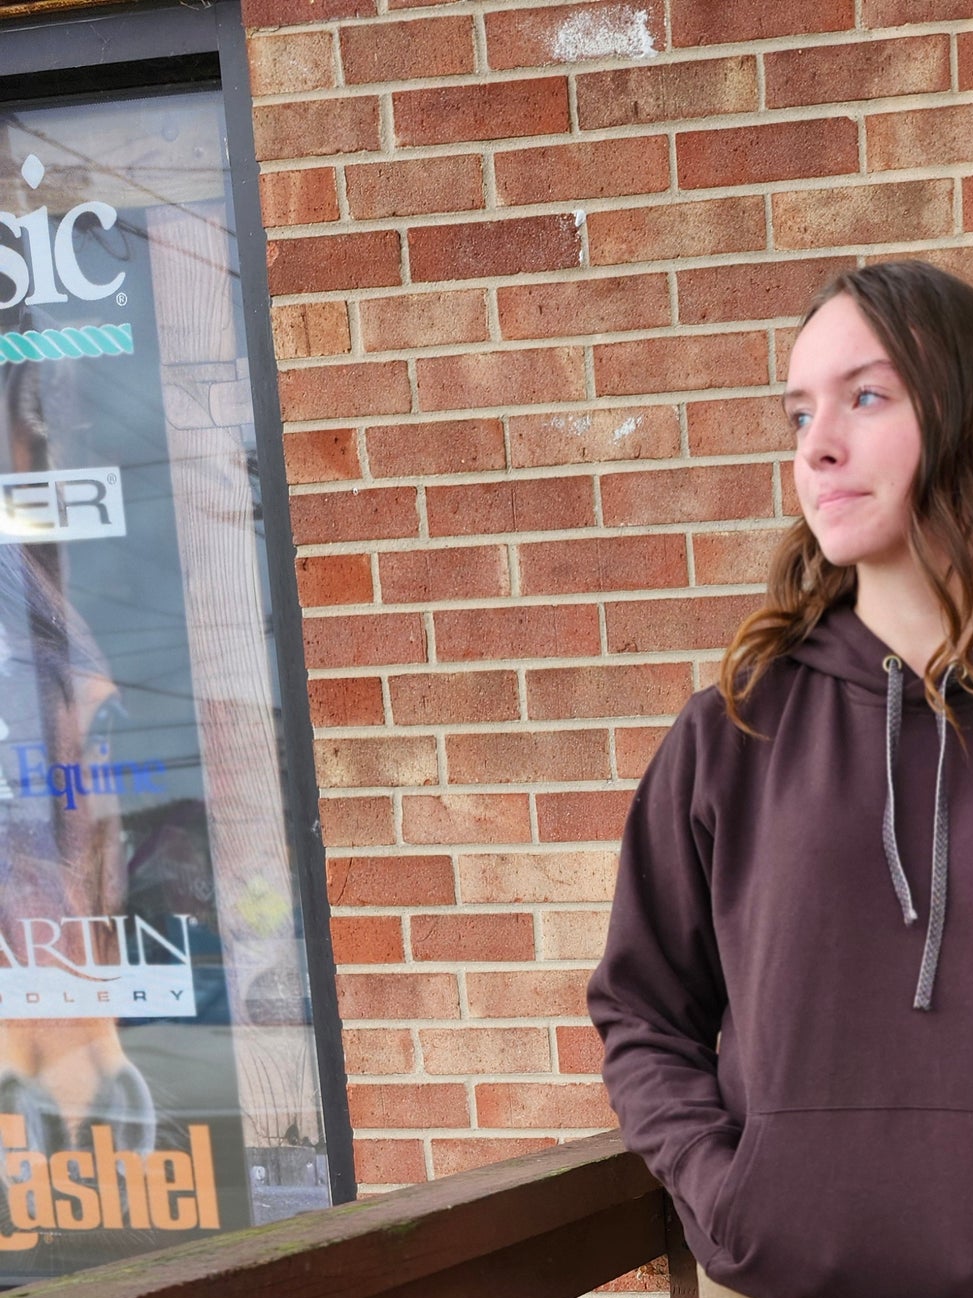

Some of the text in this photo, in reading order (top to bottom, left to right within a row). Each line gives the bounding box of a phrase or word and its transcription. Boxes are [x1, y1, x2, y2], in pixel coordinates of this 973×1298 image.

[11, 743, 166, 810] Equine
[0, 989, 183, 1004] DLERY
[0, 1113, 220, 1251] Cashel
